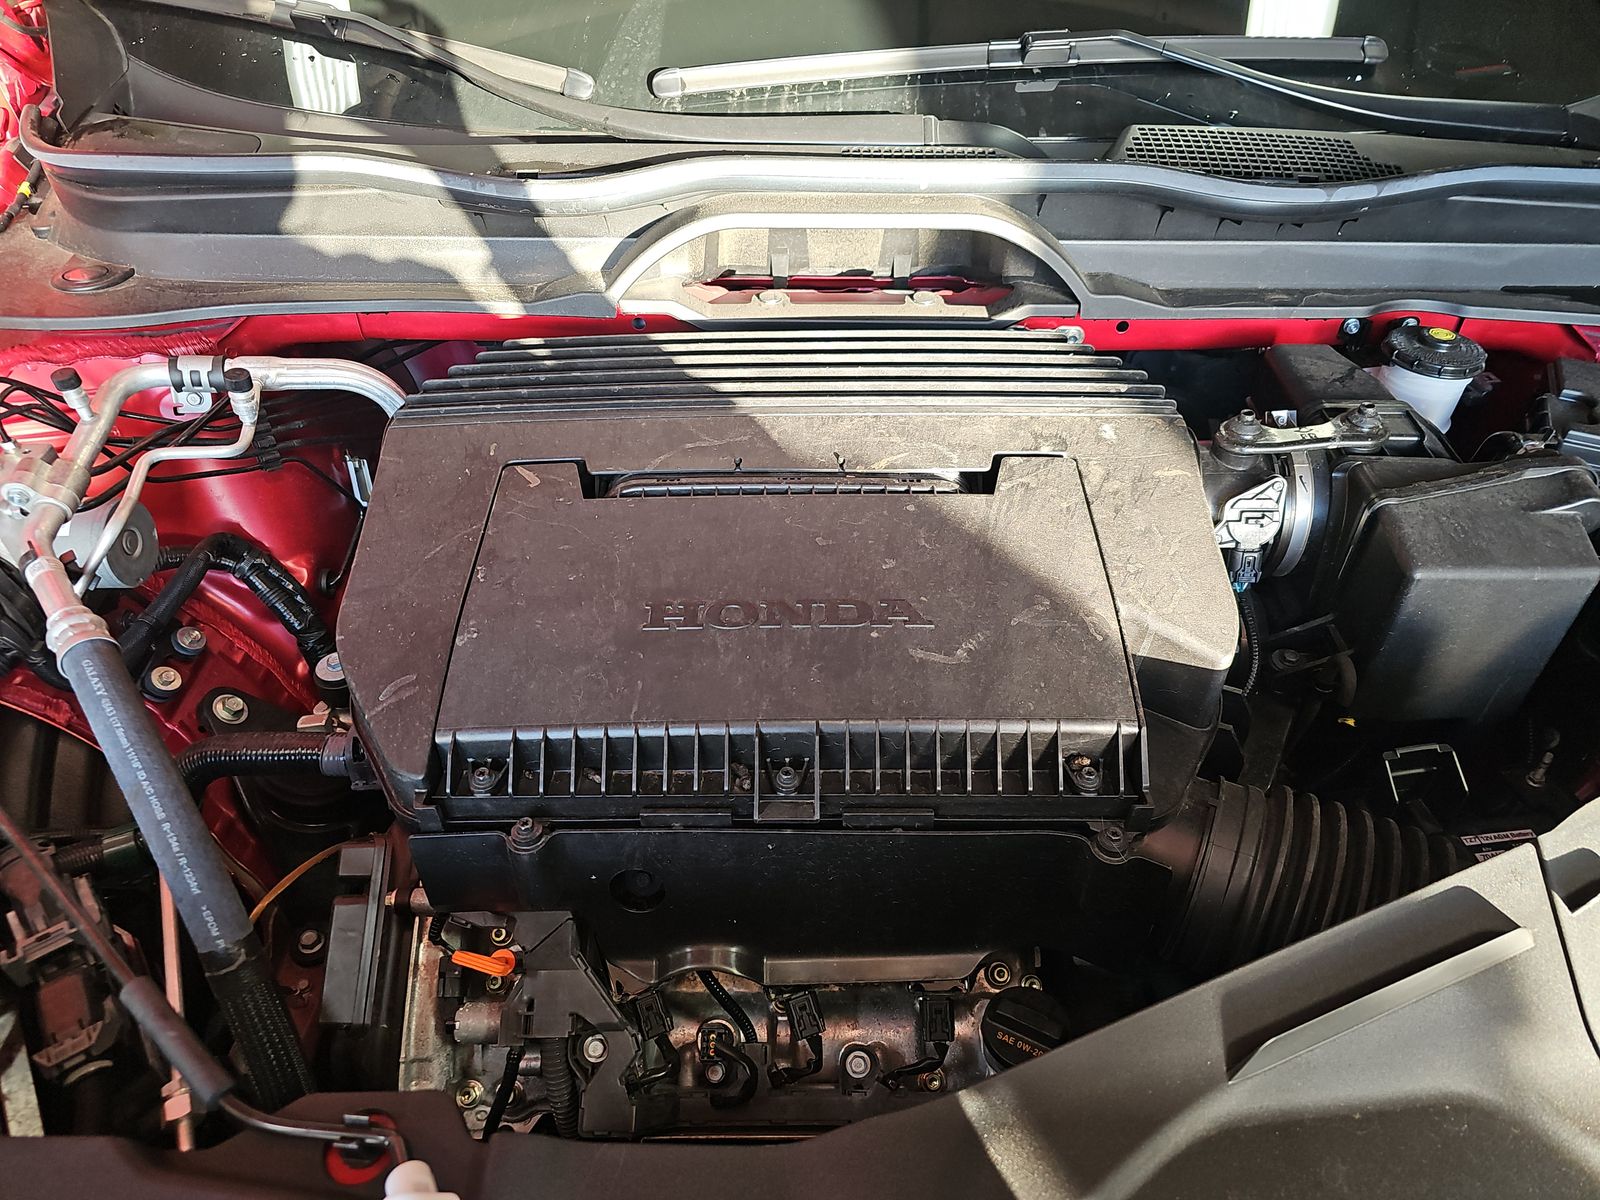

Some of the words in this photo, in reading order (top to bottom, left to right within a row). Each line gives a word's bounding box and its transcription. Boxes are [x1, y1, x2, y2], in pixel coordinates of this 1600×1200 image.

[641, 599, 935, 632] HONDA
[81, 659, 107, 695] GALAXY
[136, 768, 147, 781] ID
[149, 795, 167, 821] HOSE
[996, 1031, 1016, 1046] SAE
